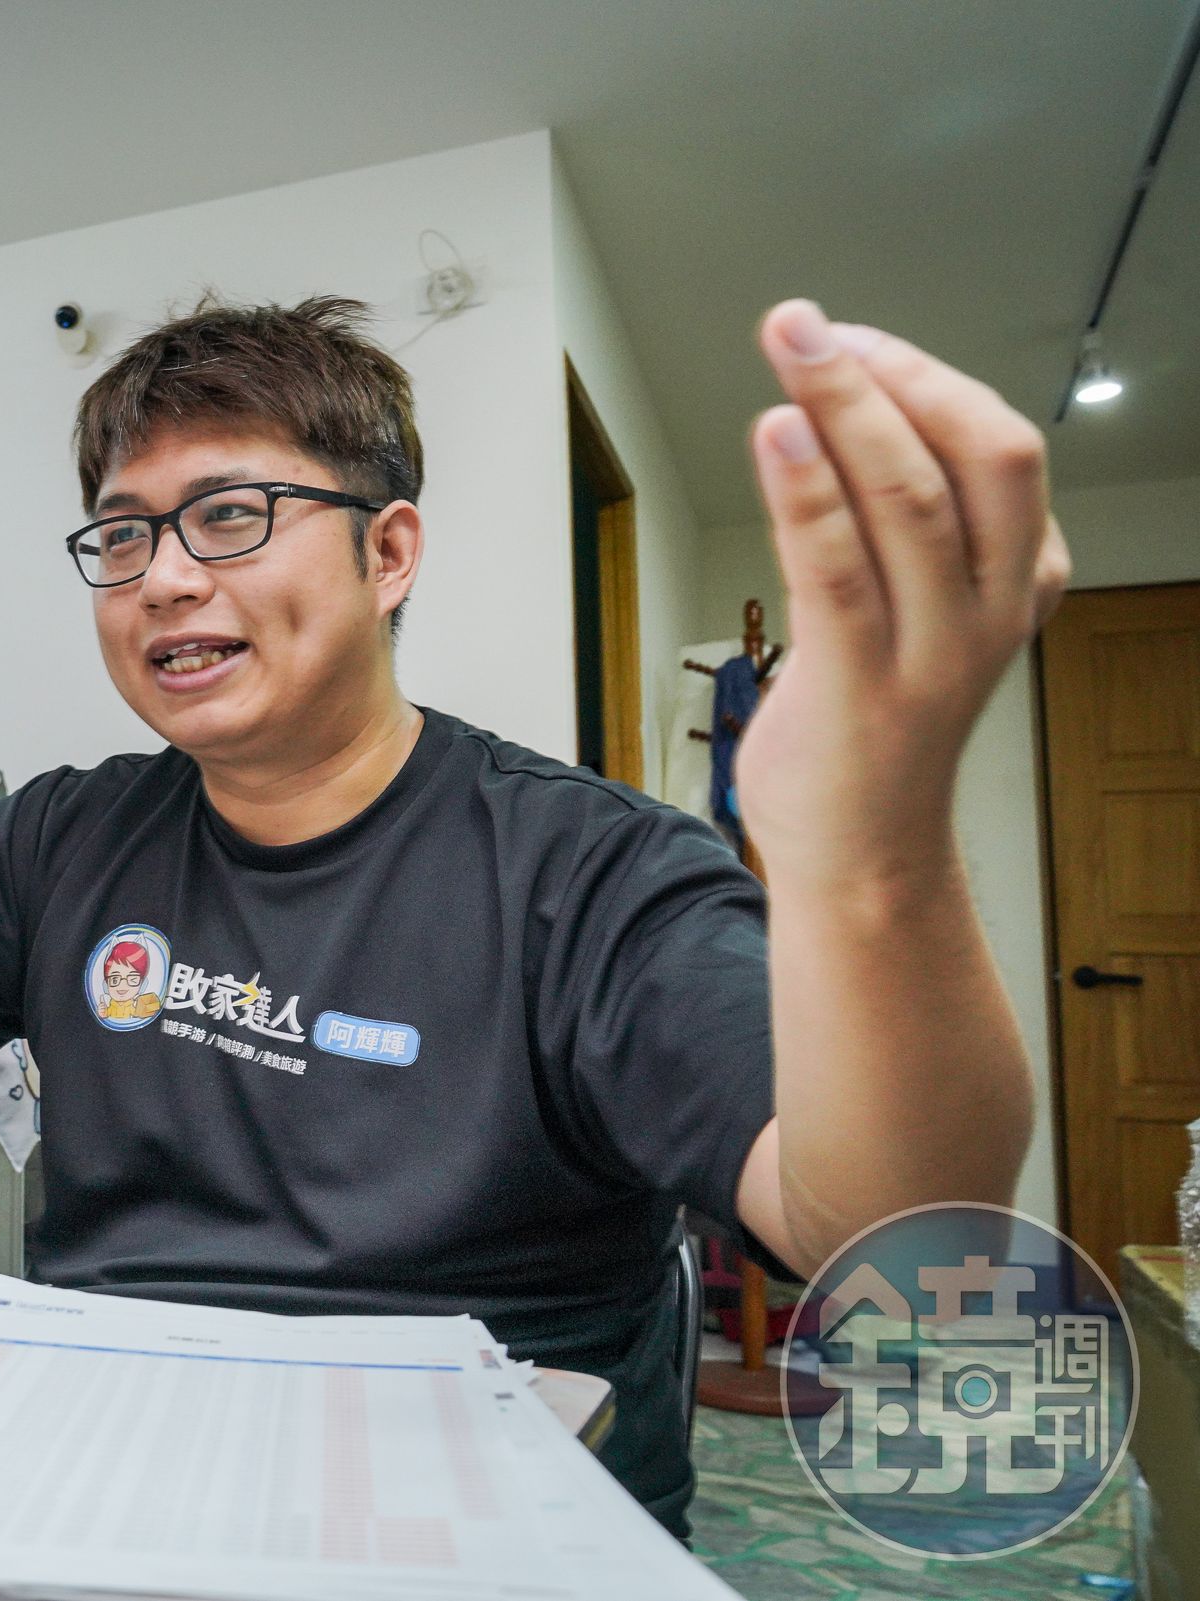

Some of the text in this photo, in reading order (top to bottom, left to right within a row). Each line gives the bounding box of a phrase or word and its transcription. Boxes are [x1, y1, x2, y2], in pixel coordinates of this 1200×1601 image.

[165, 962, 306, 1043] 敗家達人
[325, 1018, 409, 1059] 阿輝輝
